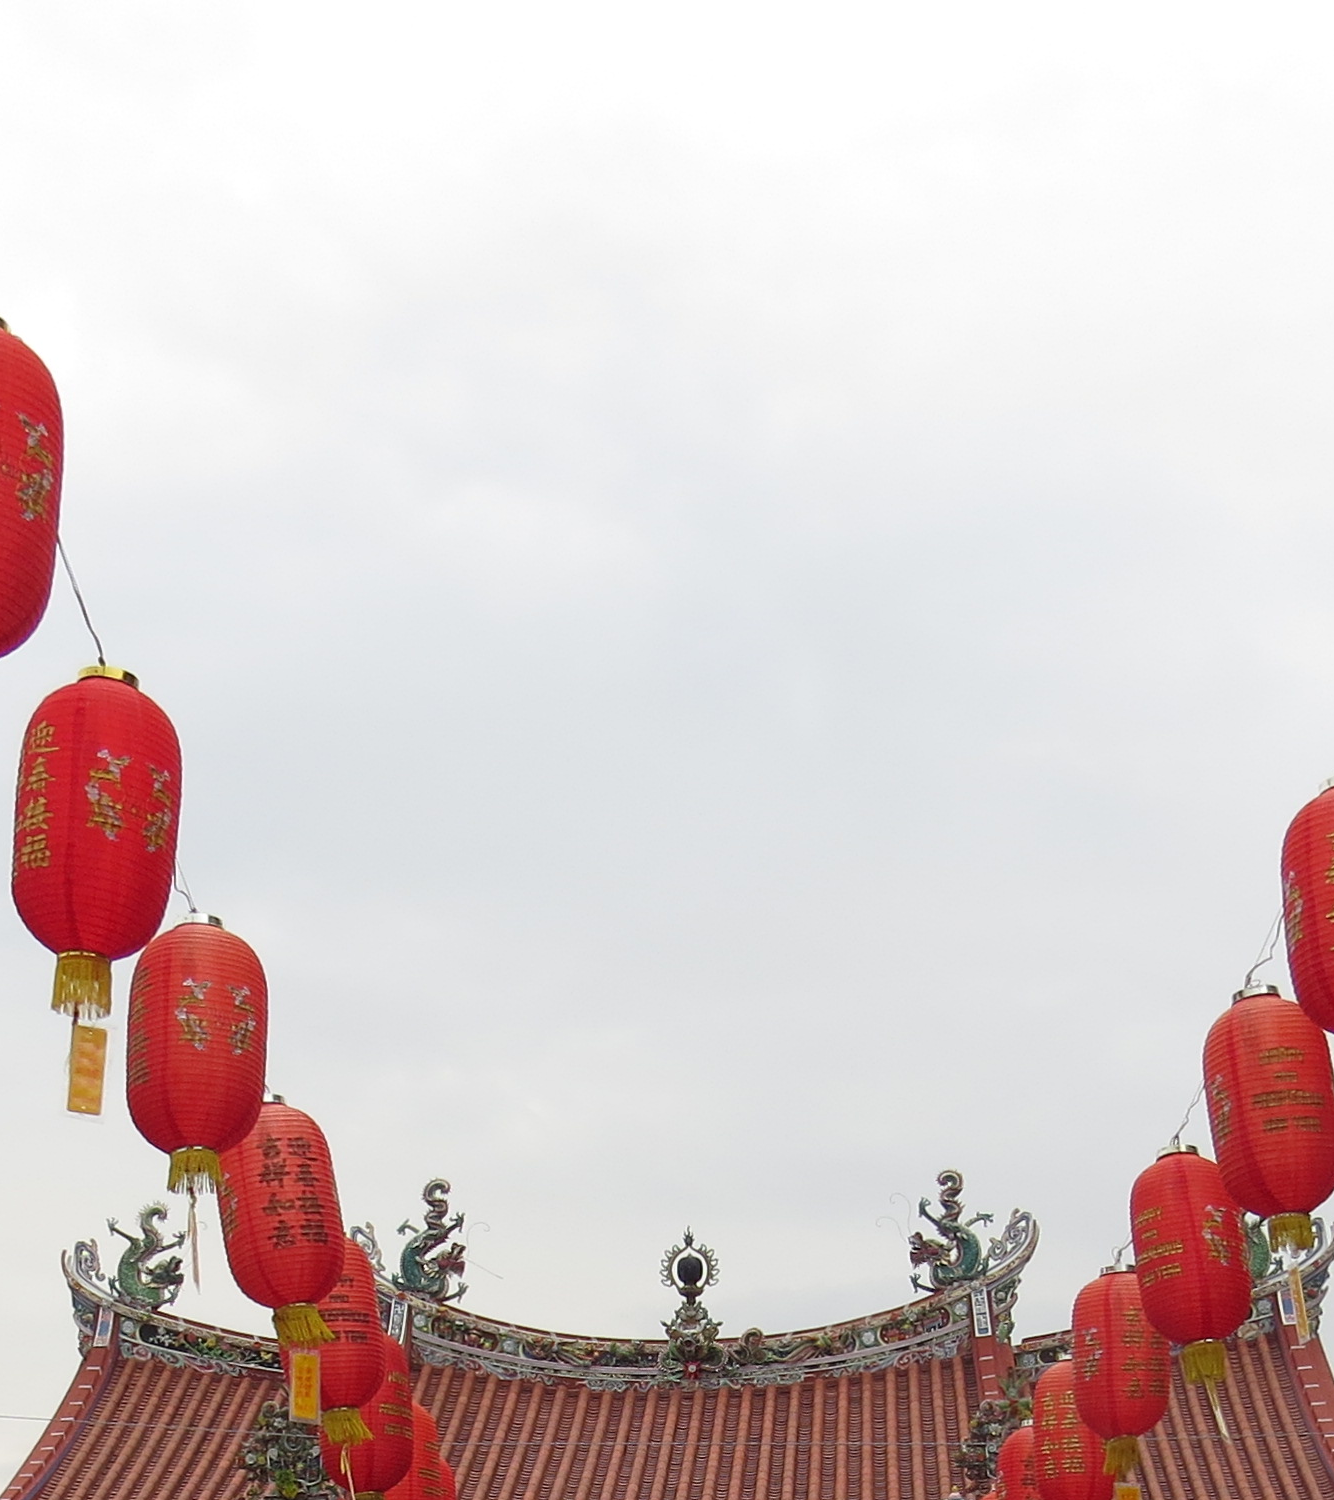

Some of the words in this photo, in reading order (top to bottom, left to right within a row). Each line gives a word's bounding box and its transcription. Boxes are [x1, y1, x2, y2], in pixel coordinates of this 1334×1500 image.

[20, 720, 59, 868] 迎春接福
[257, 1135, 297, 1247] 吉祥如意
